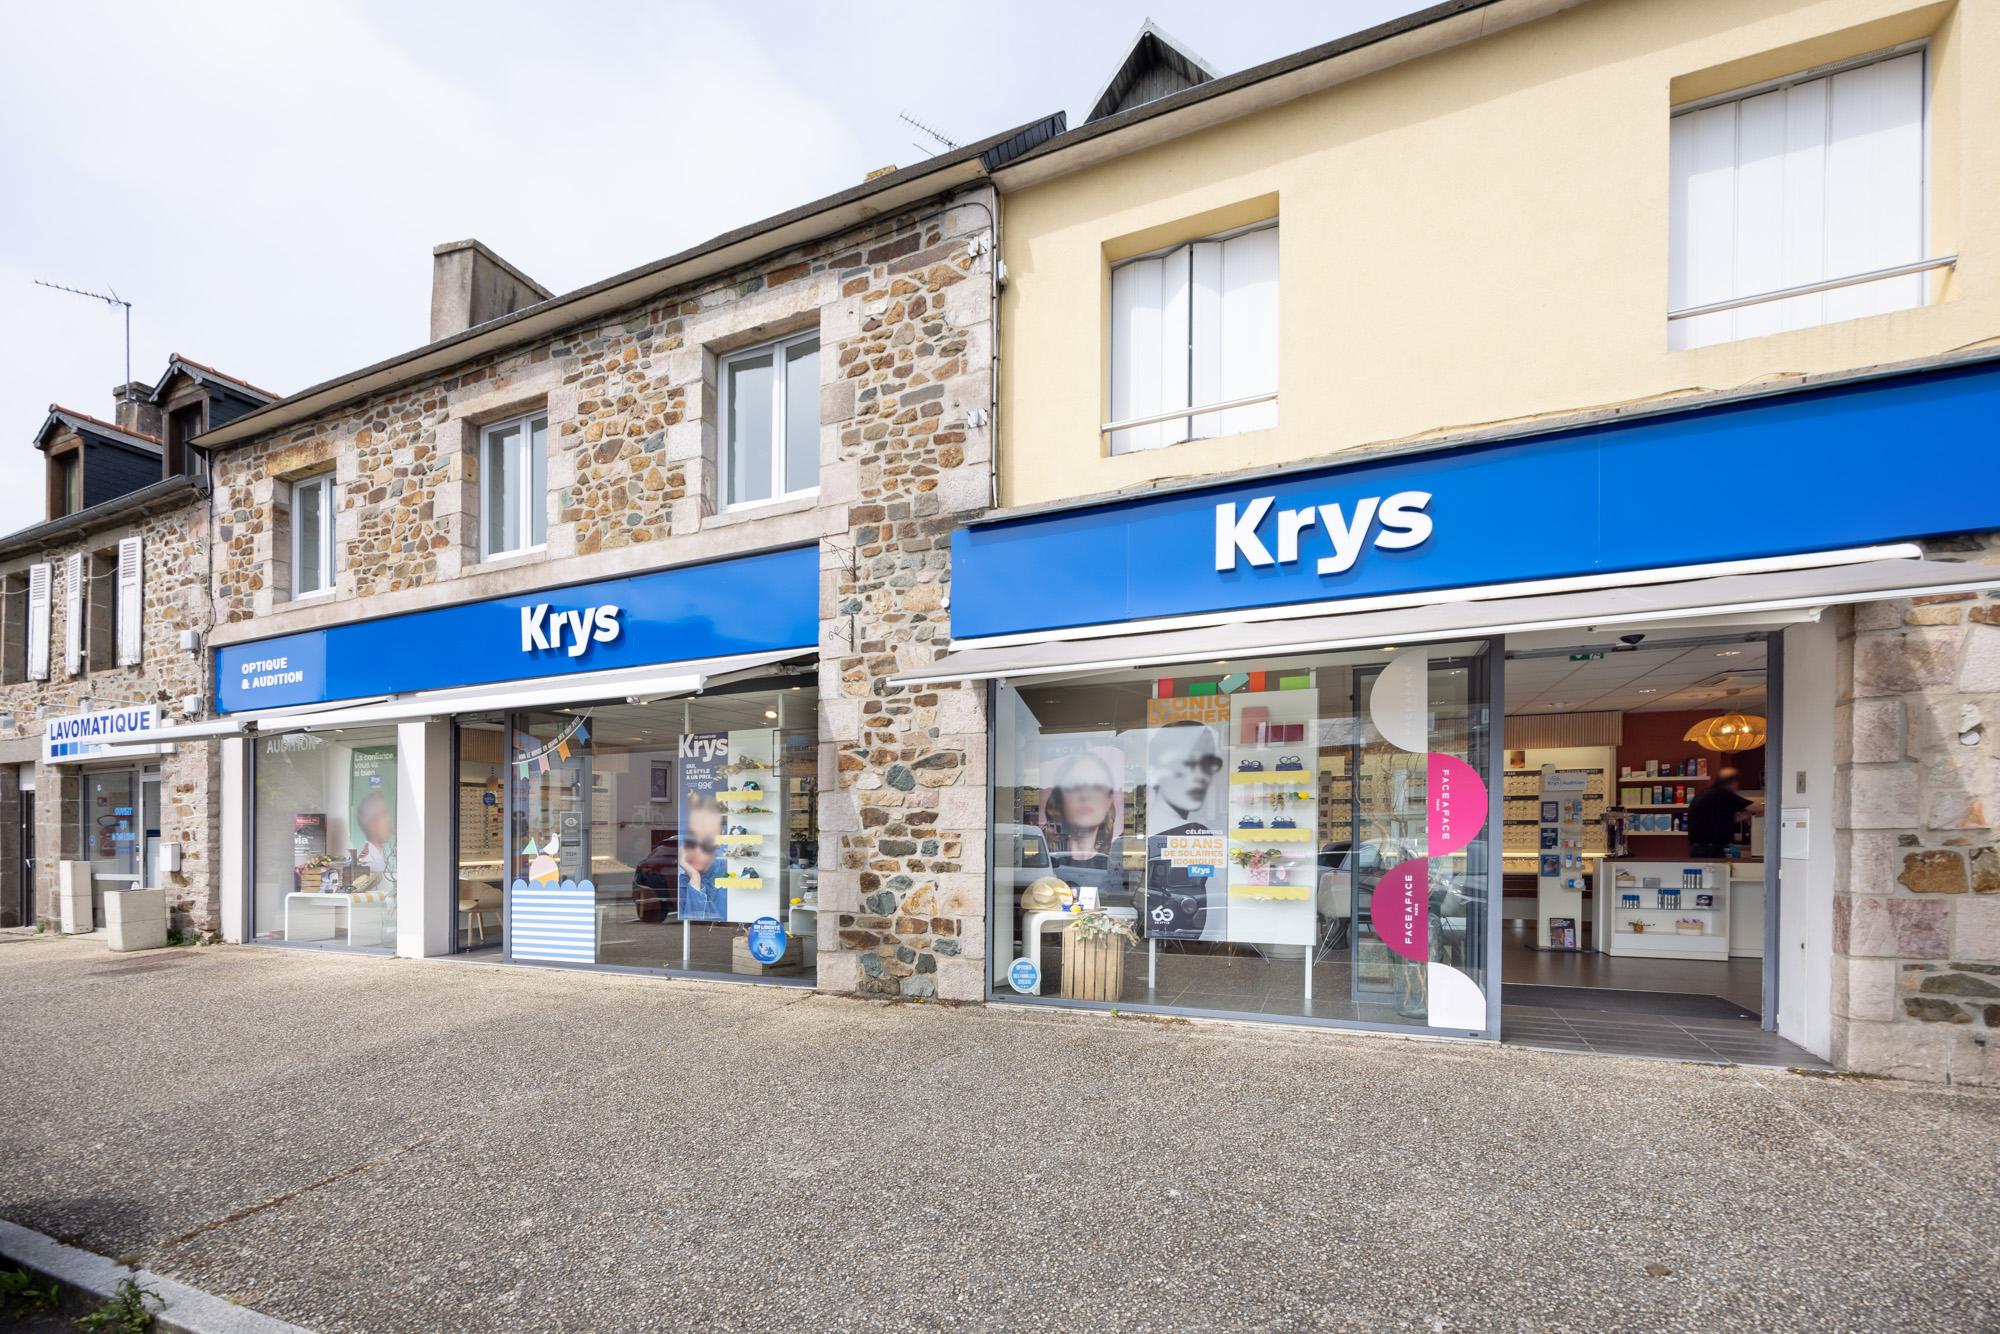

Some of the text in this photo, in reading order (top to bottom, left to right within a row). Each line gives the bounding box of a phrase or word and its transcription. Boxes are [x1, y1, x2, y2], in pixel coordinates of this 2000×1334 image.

[1216, 491, 1433, 575] Krys
[521, 603, 620, 657] Krys
[241, 657, 288, 674] OPTIQUE
[241, 670, 304, 690] & AUDITION
[50, 711, 151, 741] LAVOMATIQUE
[679, 733, 728, 762] Krys
[1442, 769, 1450, 840] FACEAFACE
[1170, 838, 1188, 849] 60
[1192, 838, 1223, 849] ANS
[1191, 866, 1211, 875] Krys
[1404, 874, 1413, 944] FACEAFACE
